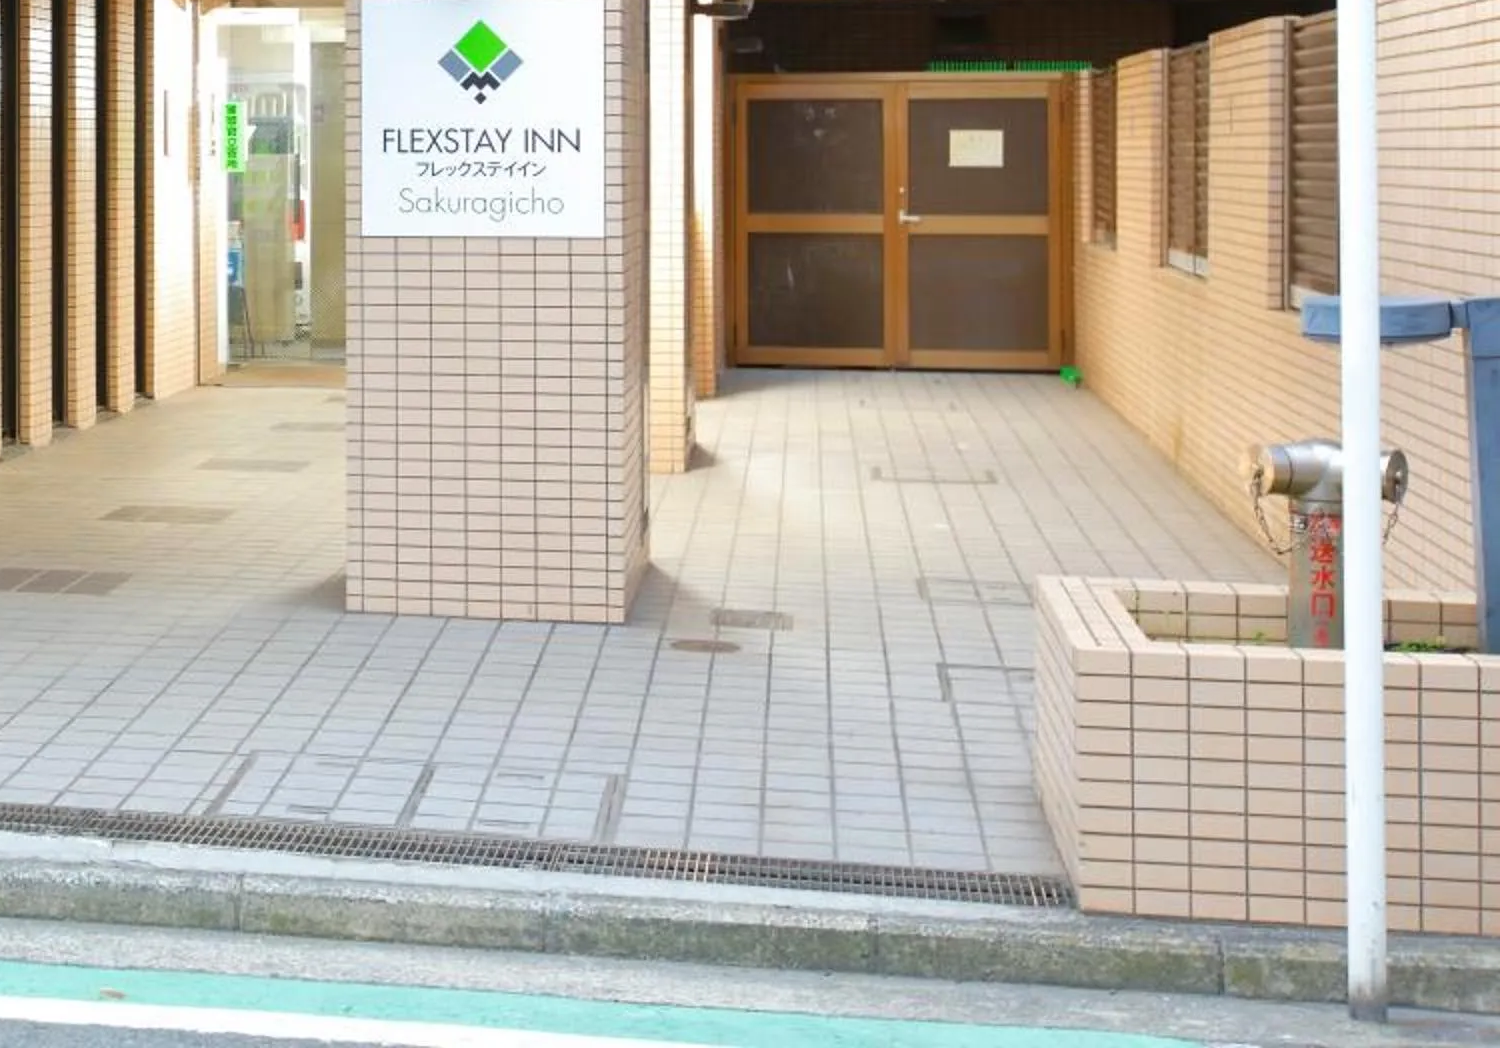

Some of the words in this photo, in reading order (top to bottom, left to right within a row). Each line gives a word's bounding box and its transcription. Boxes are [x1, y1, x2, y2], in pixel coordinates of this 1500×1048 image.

[382, 127, 512, 154] FLEXSTAY
[524, 127, 582, 153] INN
[416, 160, 547, 178] フレックステイイン
[398, 186, 565, 223] Sakuragicho
